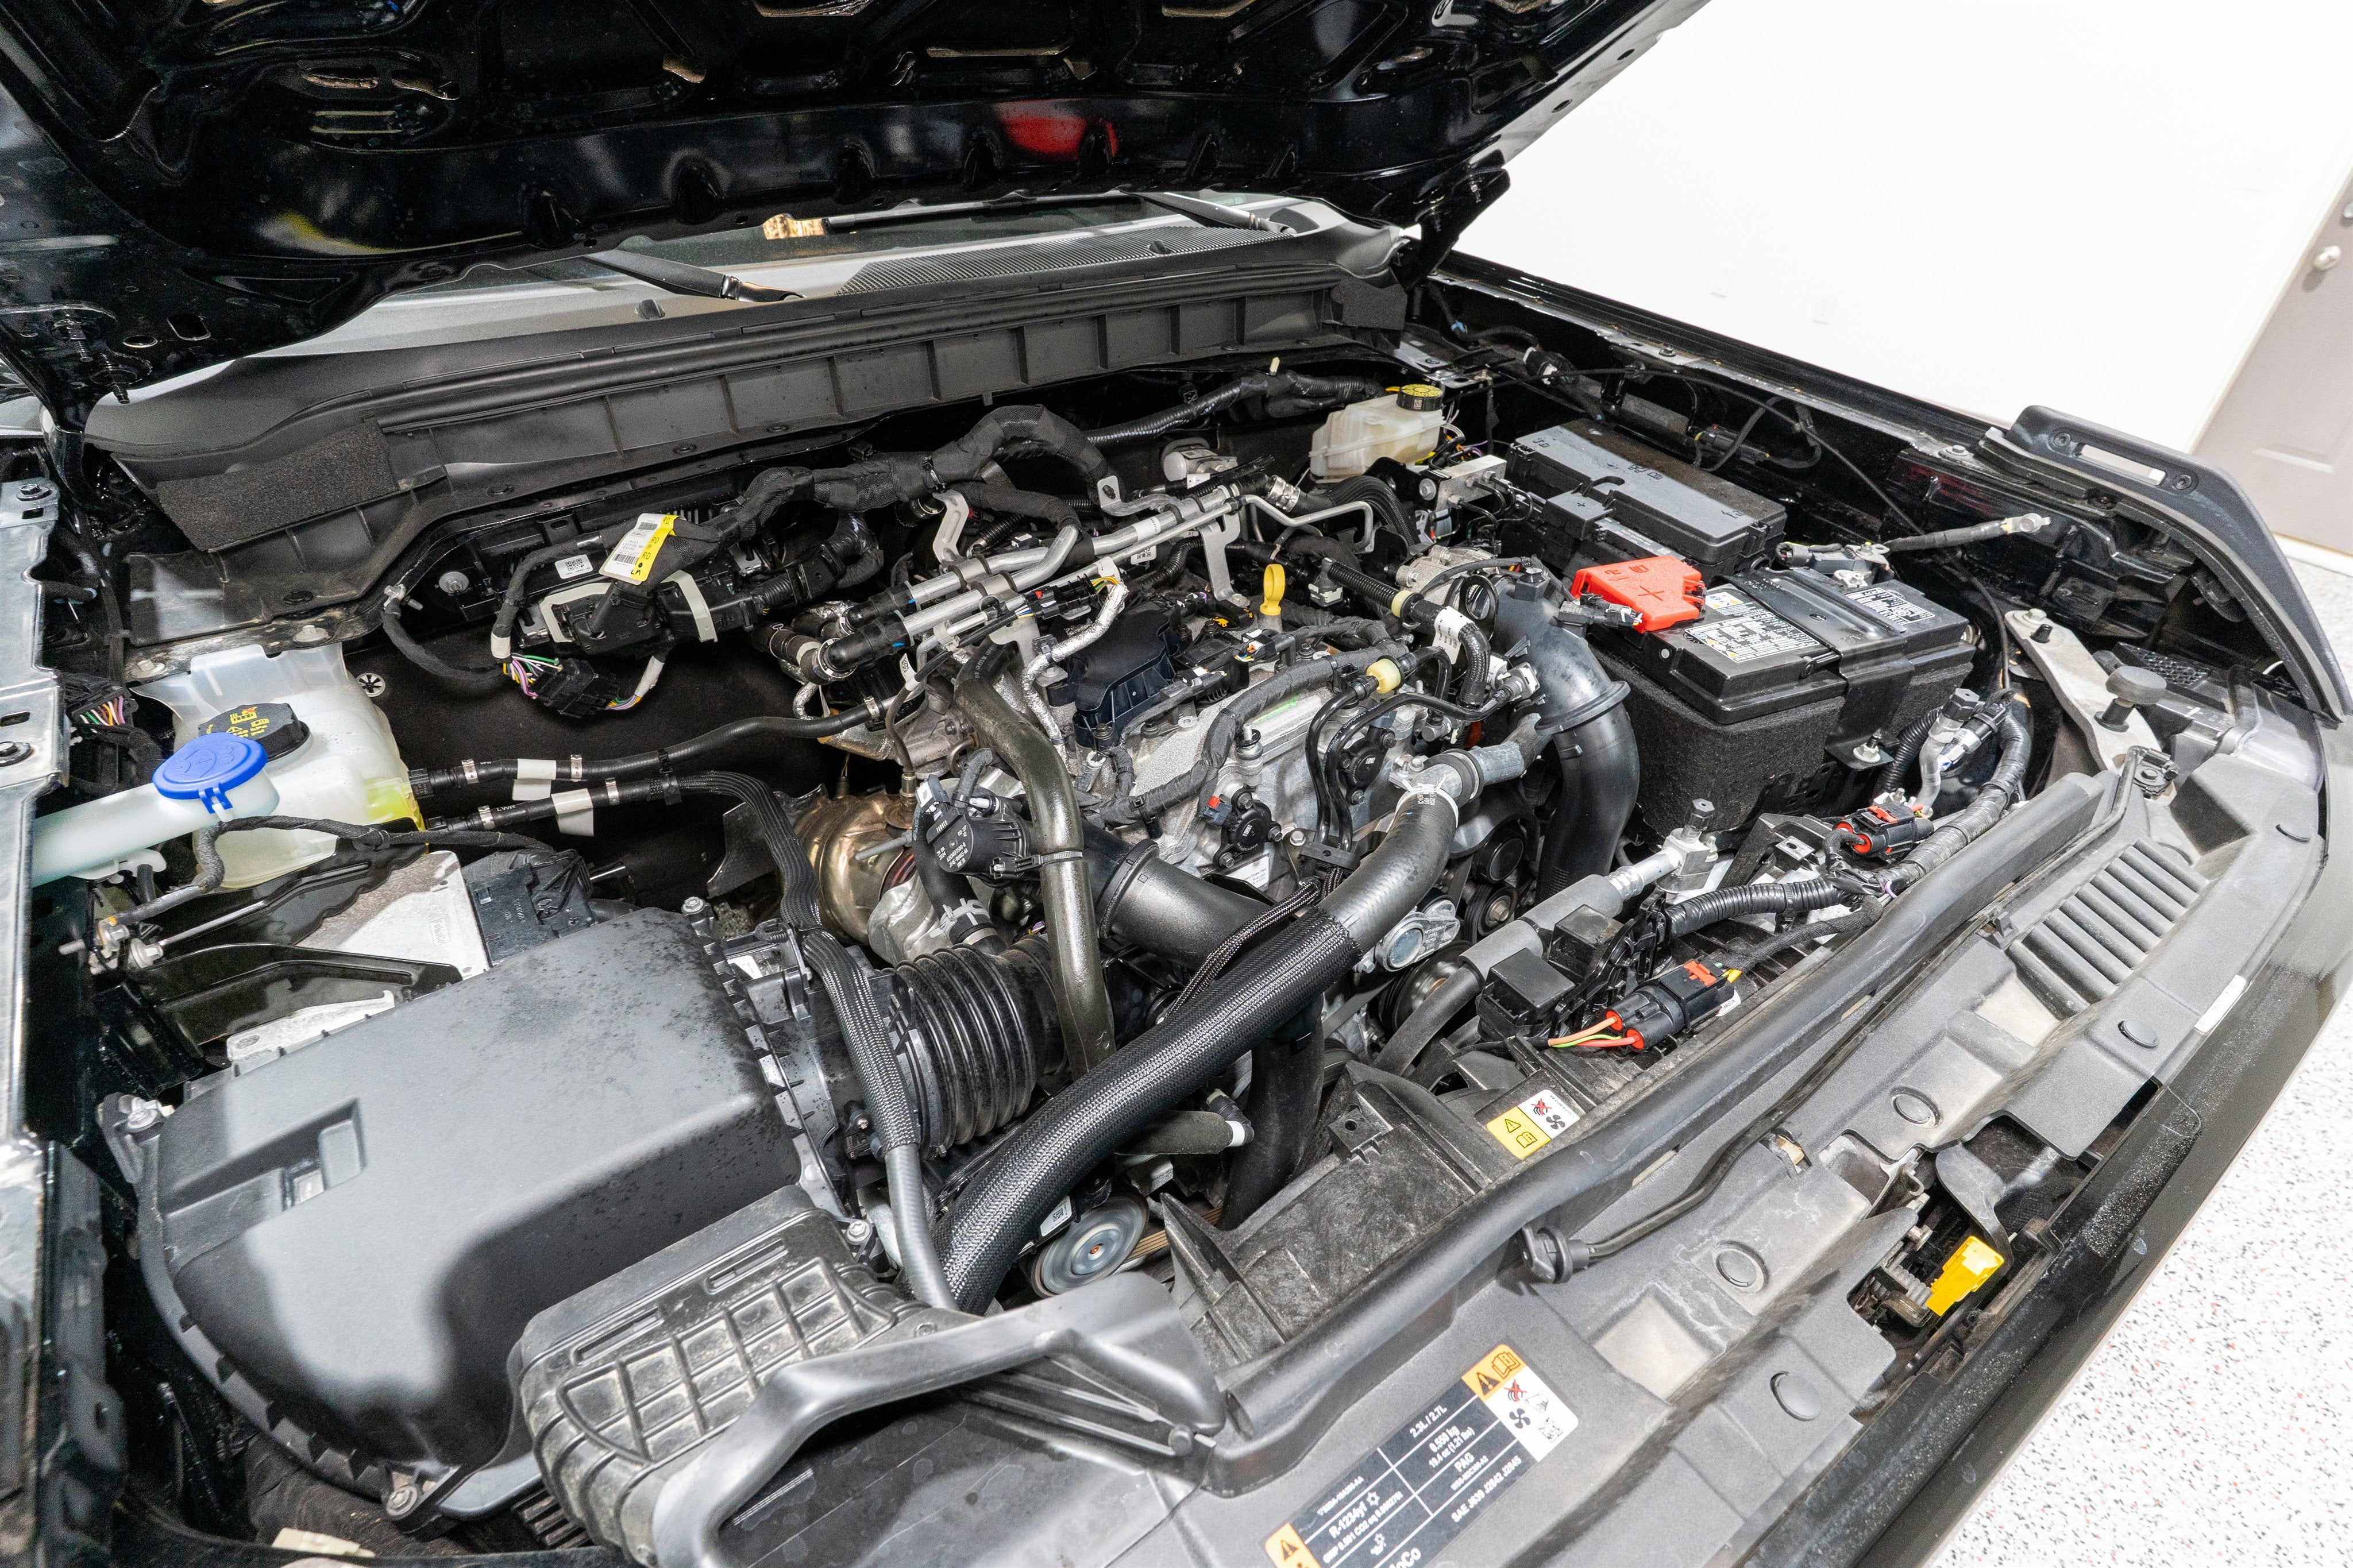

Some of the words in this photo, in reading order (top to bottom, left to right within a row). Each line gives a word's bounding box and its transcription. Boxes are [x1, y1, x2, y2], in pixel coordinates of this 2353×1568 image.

[641, 551, 651, 560] RD
[1409, 1419, 1429, 1438] 2.3L
[1429, 1405, 1448, 1422] 2.7L
[1446, 1426, 1461, 1439] kg
[1454, 1452, 1475, 1473] PAG
[1451, 1504, 1469, 1523] SAE
[1467, 1489, 1486, 1509] J639
[1483, 1472, 1504, 1494] J2842
[1502, 1455, 1522, 1477] J2845
[1328, 1501, 1368, 1539] R-1234yf
[1354, 1520, 1371, 1536] CO2
